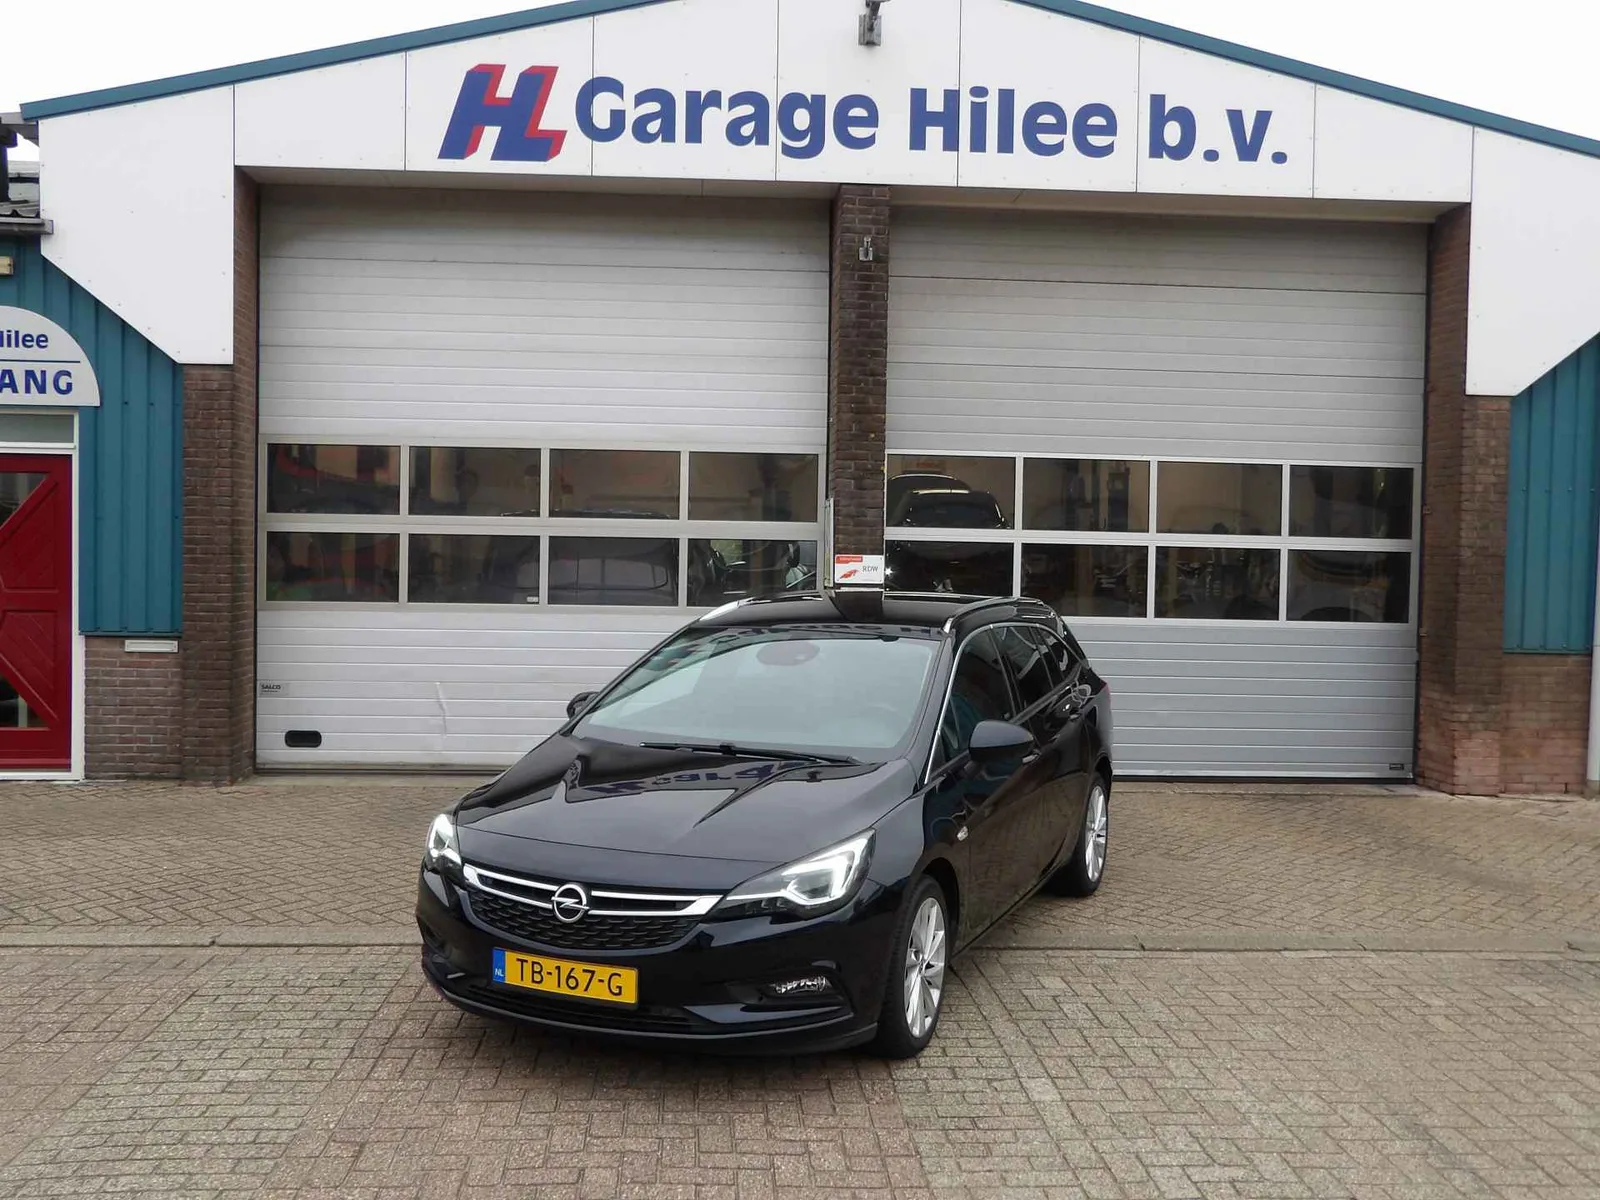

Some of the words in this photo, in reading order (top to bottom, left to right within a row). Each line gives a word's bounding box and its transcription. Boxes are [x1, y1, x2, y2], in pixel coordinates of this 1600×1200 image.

[575, 76, 880, 160] Garage
[909, 85, 1118, 158] Hilee
[1148, 93, 1289, 165] b.v.
[862, 565, 879, 573] RDW
[494, 968, 504, 977] NL
[516, 958, 623, 997] TB-167-G
